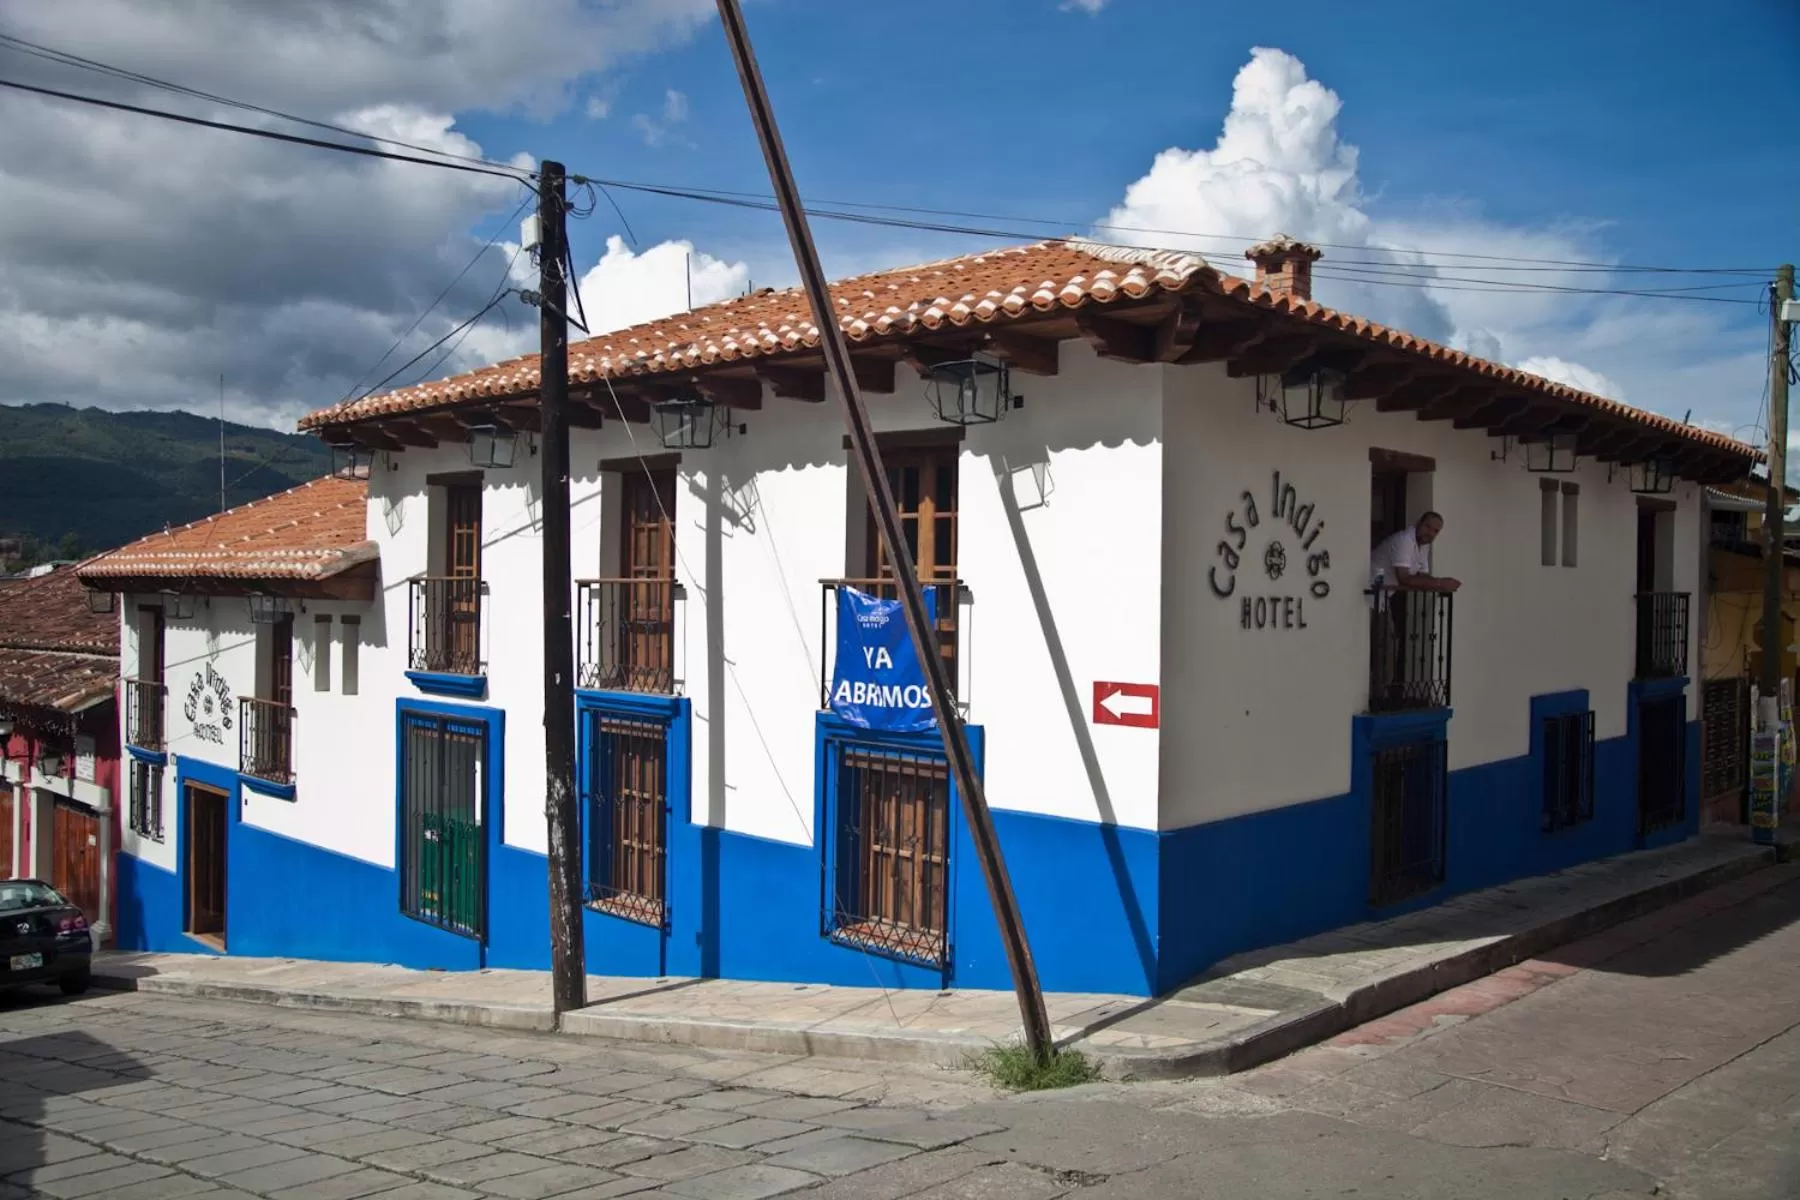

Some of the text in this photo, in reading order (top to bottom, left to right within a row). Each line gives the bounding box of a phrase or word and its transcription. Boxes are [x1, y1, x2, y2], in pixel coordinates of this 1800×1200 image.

[1209, 470, 1330, 598] Casa Indigo
[1240, 596, 1308, 630] HOTEL
[863, 646, 893, 669] YA
[834, 679, 932, 709] ABRIMOS
